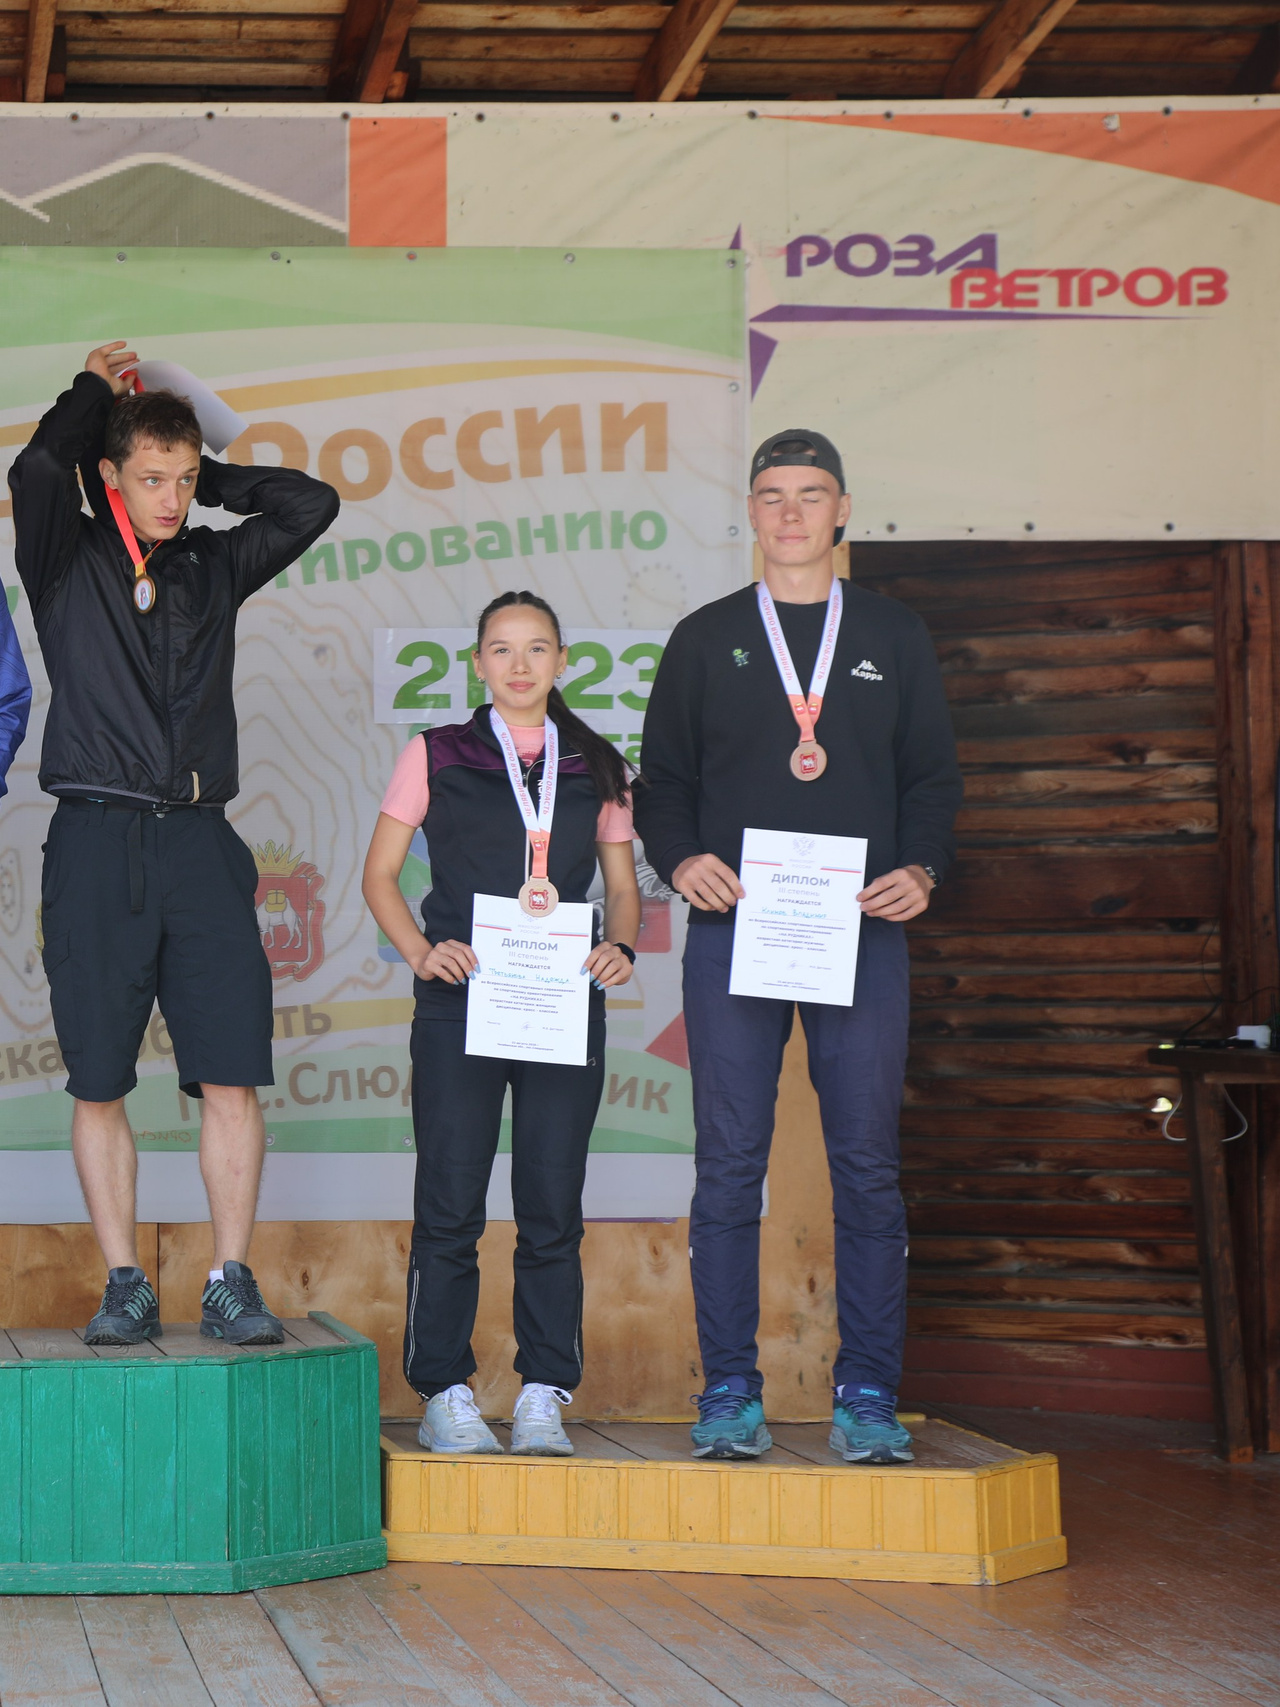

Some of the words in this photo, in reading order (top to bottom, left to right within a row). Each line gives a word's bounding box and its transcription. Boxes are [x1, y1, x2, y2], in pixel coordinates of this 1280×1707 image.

[786, 234, 998, 277] РОЗА
[950, 267, 1228, 308] ВЕТРОВ
[851, 668, 883, 681] Kappa
[771, 873, 830, 887] ДИПЛОМ
[502, 938, 558, 951] ДИПЛОМ
[860, 1388, 880, 1397] HOKA
